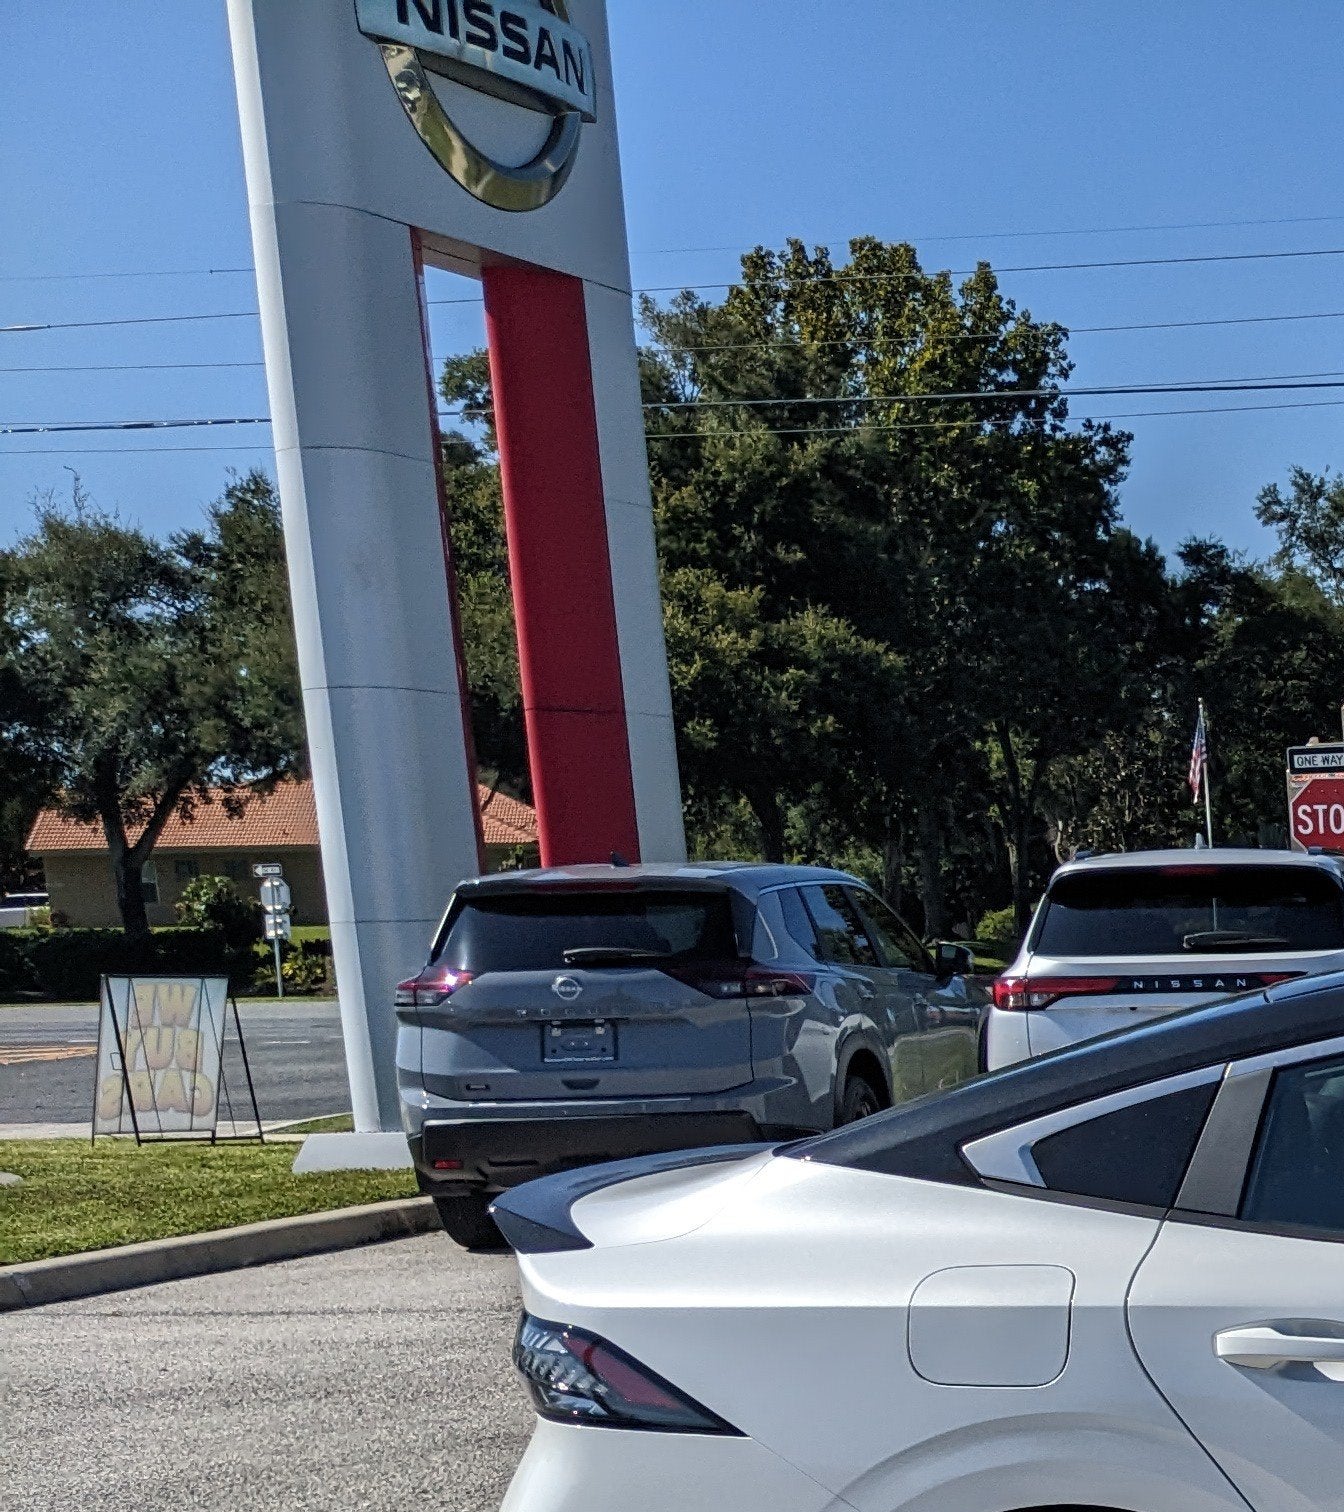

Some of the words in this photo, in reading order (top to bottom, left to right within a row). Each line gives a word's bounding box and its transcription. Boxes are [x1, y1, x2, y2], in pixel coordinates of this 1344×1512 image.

[396, 0, 588, 96] NISSAN
[1296, 756, 1319, 767] ONE
[1321, 754, 1344, 766] WAY
[1132, 977, 1248, 990] NISSAN
